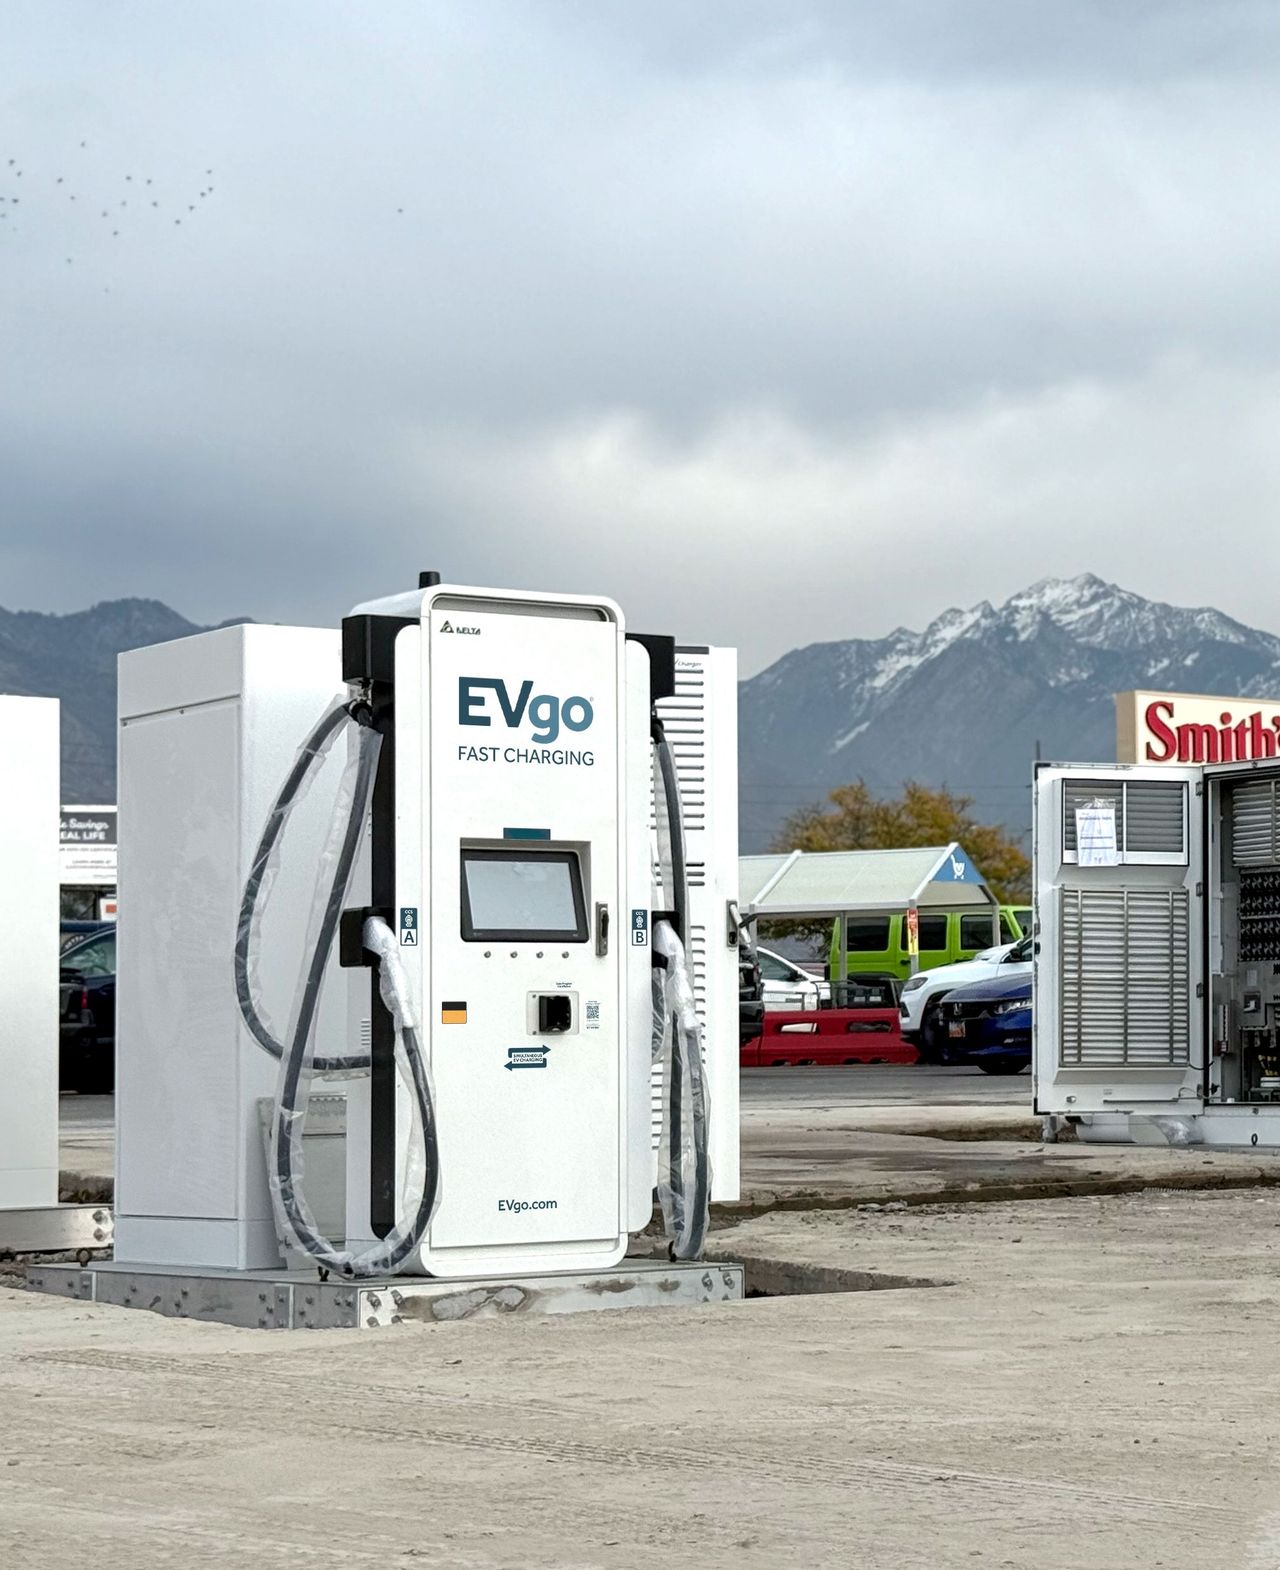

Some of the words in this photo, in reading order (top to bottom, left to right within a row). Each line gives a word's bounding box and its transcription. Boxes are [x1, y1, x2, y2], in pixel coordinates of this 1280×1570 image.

[459, 676, 594, 745] EVgo
[458, 746, 500, 762] FAST
[504, 748, 594, 766] CHARGING
[69, 818, 109, 831] Savings
[60, 831, 80, 841] EAL
[82, 831, 106, 841] LIFE
[404, 930, 414, 943] A
[636, 931, 645, 943] B
[498, 1199, 558, 1214] EVgo.com
